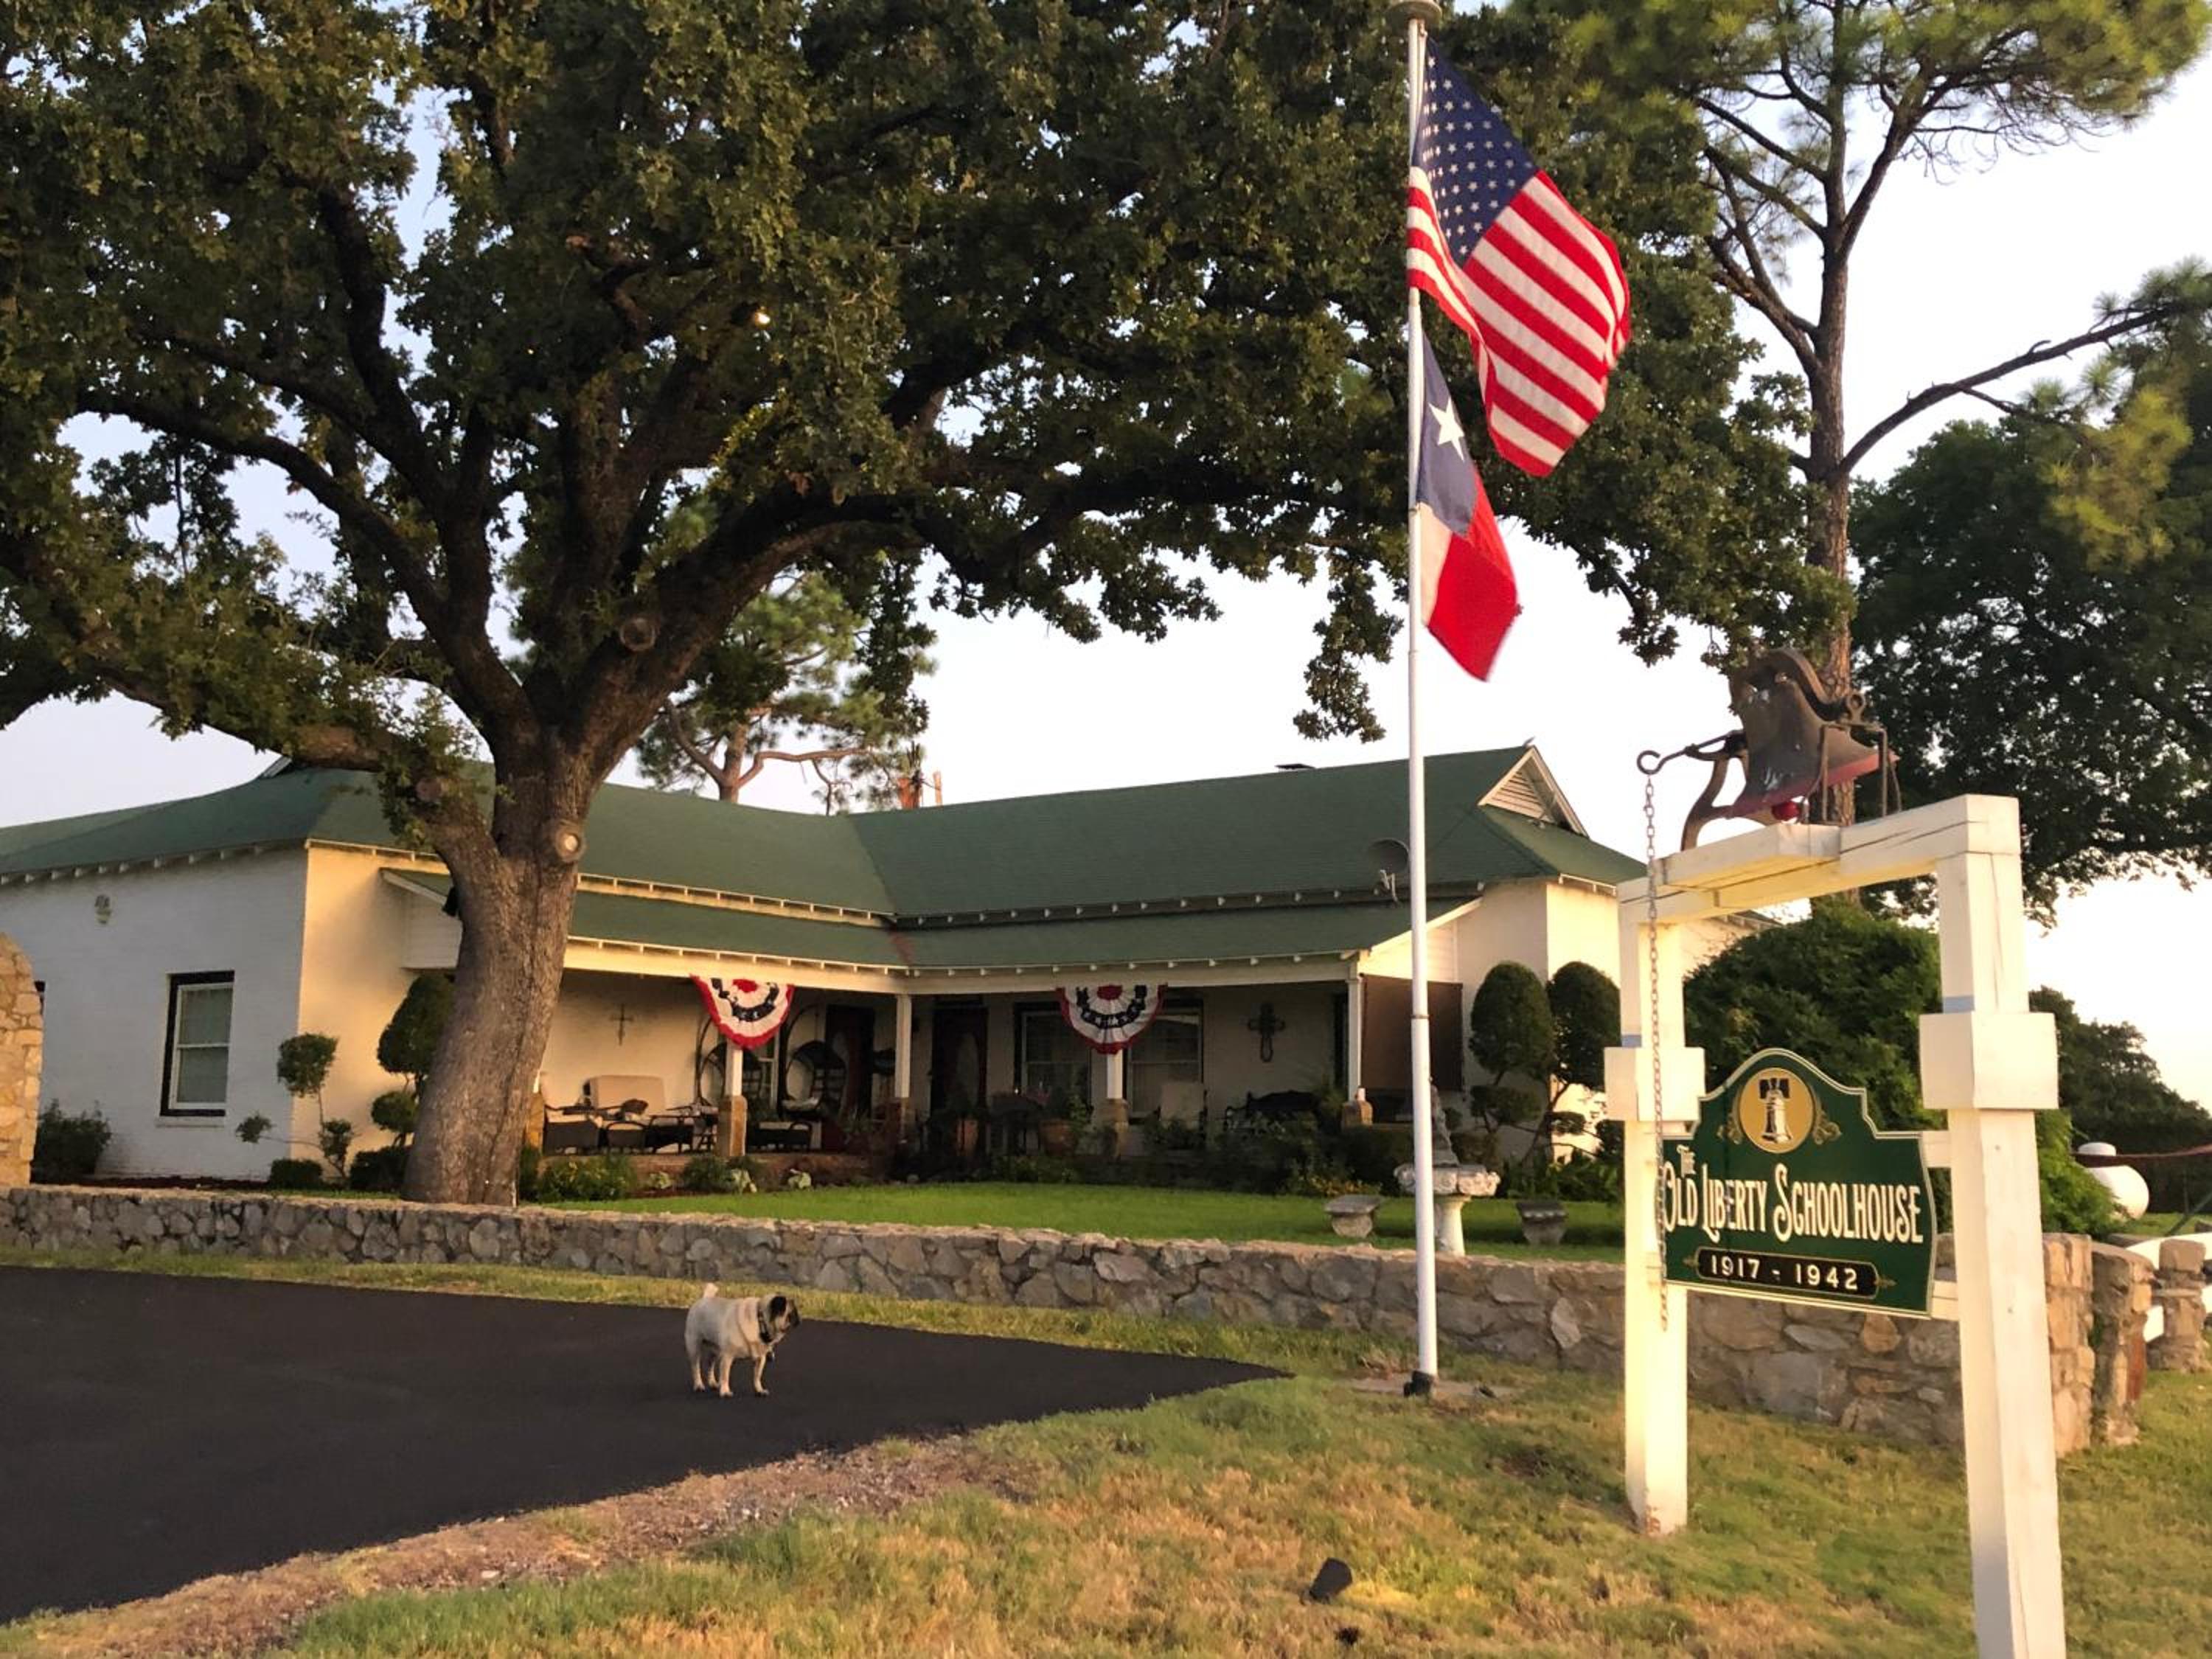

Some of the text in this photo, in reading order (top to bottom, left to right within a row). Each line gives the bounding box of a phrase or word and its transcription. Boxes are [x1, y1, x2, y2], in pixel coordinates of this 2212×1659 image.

[1662, 1161, 1923, 1243] OLD LIBERTY SCHOOLHOUSE
[1711, 1255, 1760, 1279] 1917
[1795, 1263, 1858, 1290] 1942
